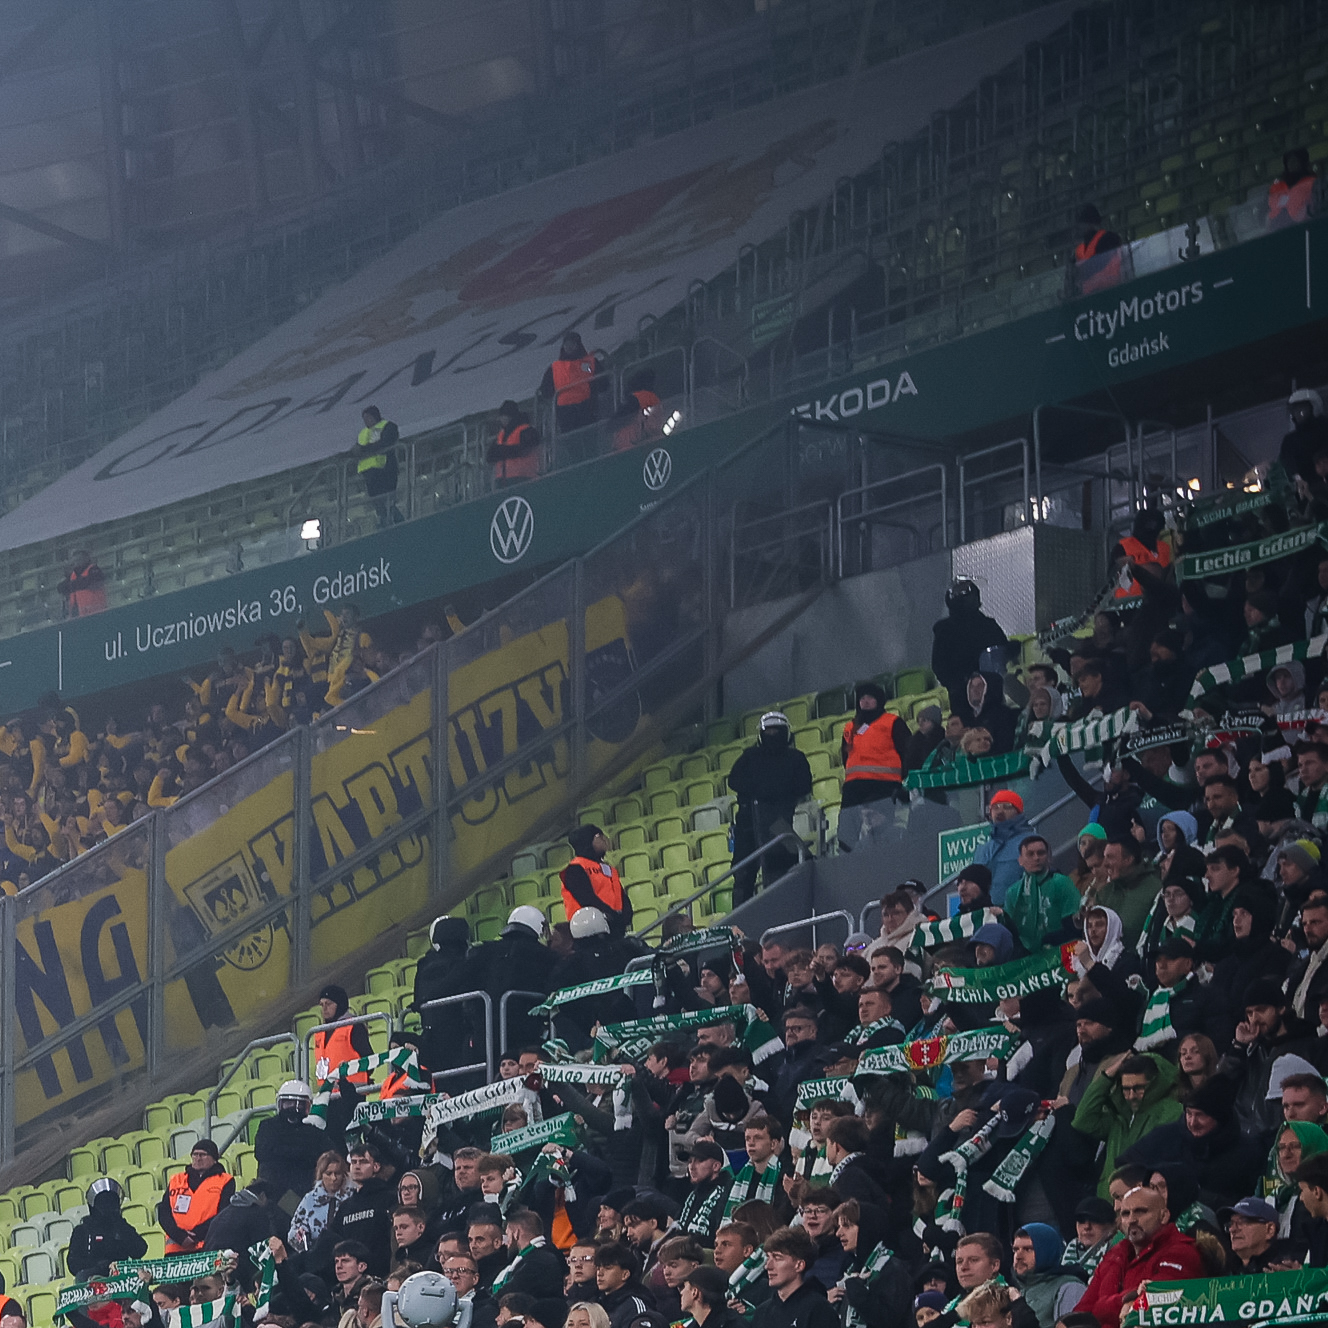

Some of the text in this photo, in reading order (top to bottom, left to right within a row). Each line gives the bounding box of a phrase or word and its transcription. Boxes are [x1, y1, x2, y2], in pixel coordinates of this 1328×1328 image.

[1074, 279, 1203, 341] CityMotors
[1108, 332, 1170, 368] Gdańsk
[1195, 551, 1251, 574] Lechia
[105, 638, 128, 661] ul.
[135, 602, 263, 653] Uczniowska
[312, 557, 392, 604] Gdańsk
[947, 829, 991, 857] WYJŚ
[947, 967, 1064, 1003] LECHIA GDAŃSK
[1138, 1303, 1226, 1327] LECHIA
